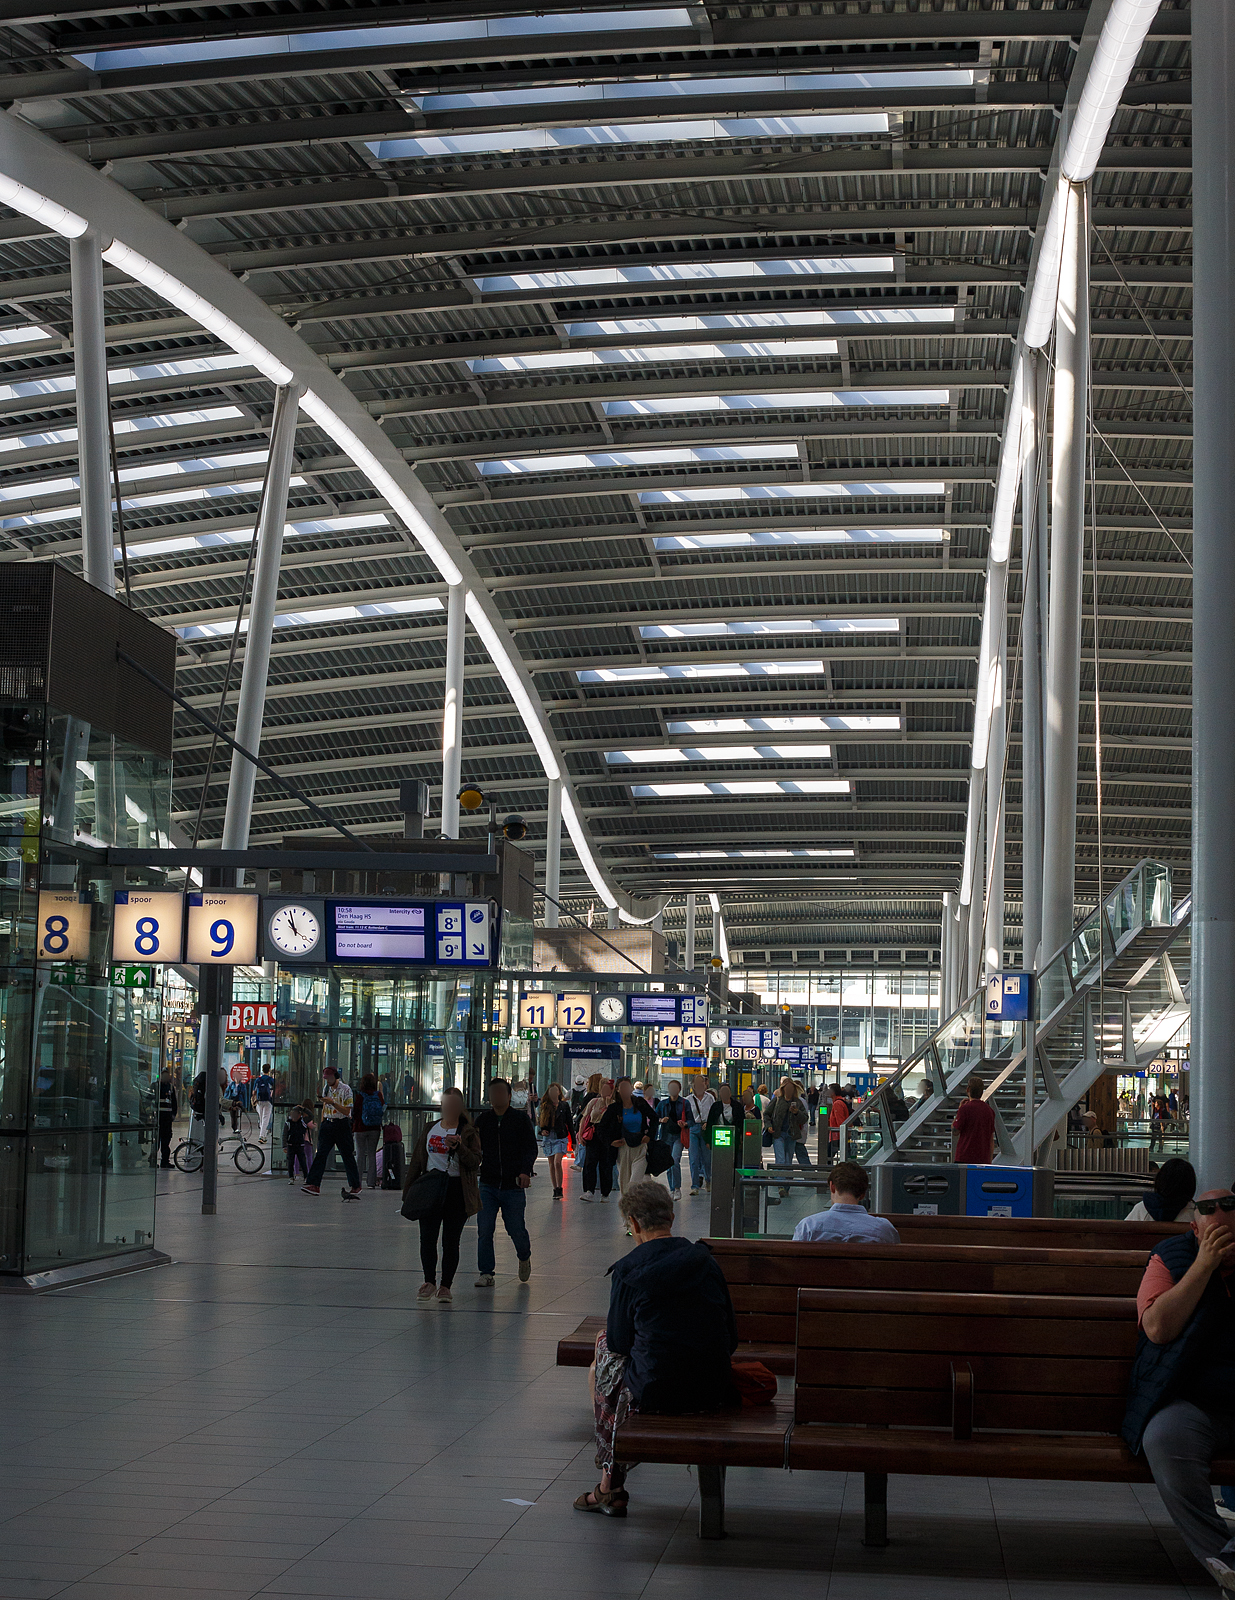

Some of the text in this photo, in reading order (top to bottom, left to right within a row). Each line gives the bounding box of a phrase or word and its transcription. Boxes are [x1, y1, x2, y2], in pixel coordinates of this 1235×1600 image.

[134, 916, 160, 956] 8
[210, 918, 234, 958] 9
[526, 1006, 544, 1024] 11
[563, 1007, 586, 1025] 12
[663, 1035, 679, 1047] 14
[687, 1035, 702, 1047] 15
[728, 1049, 739, 1058] 18
[746, 1049, 757, 1058] 19
[1151, 1064, 1161, 1072] 20
